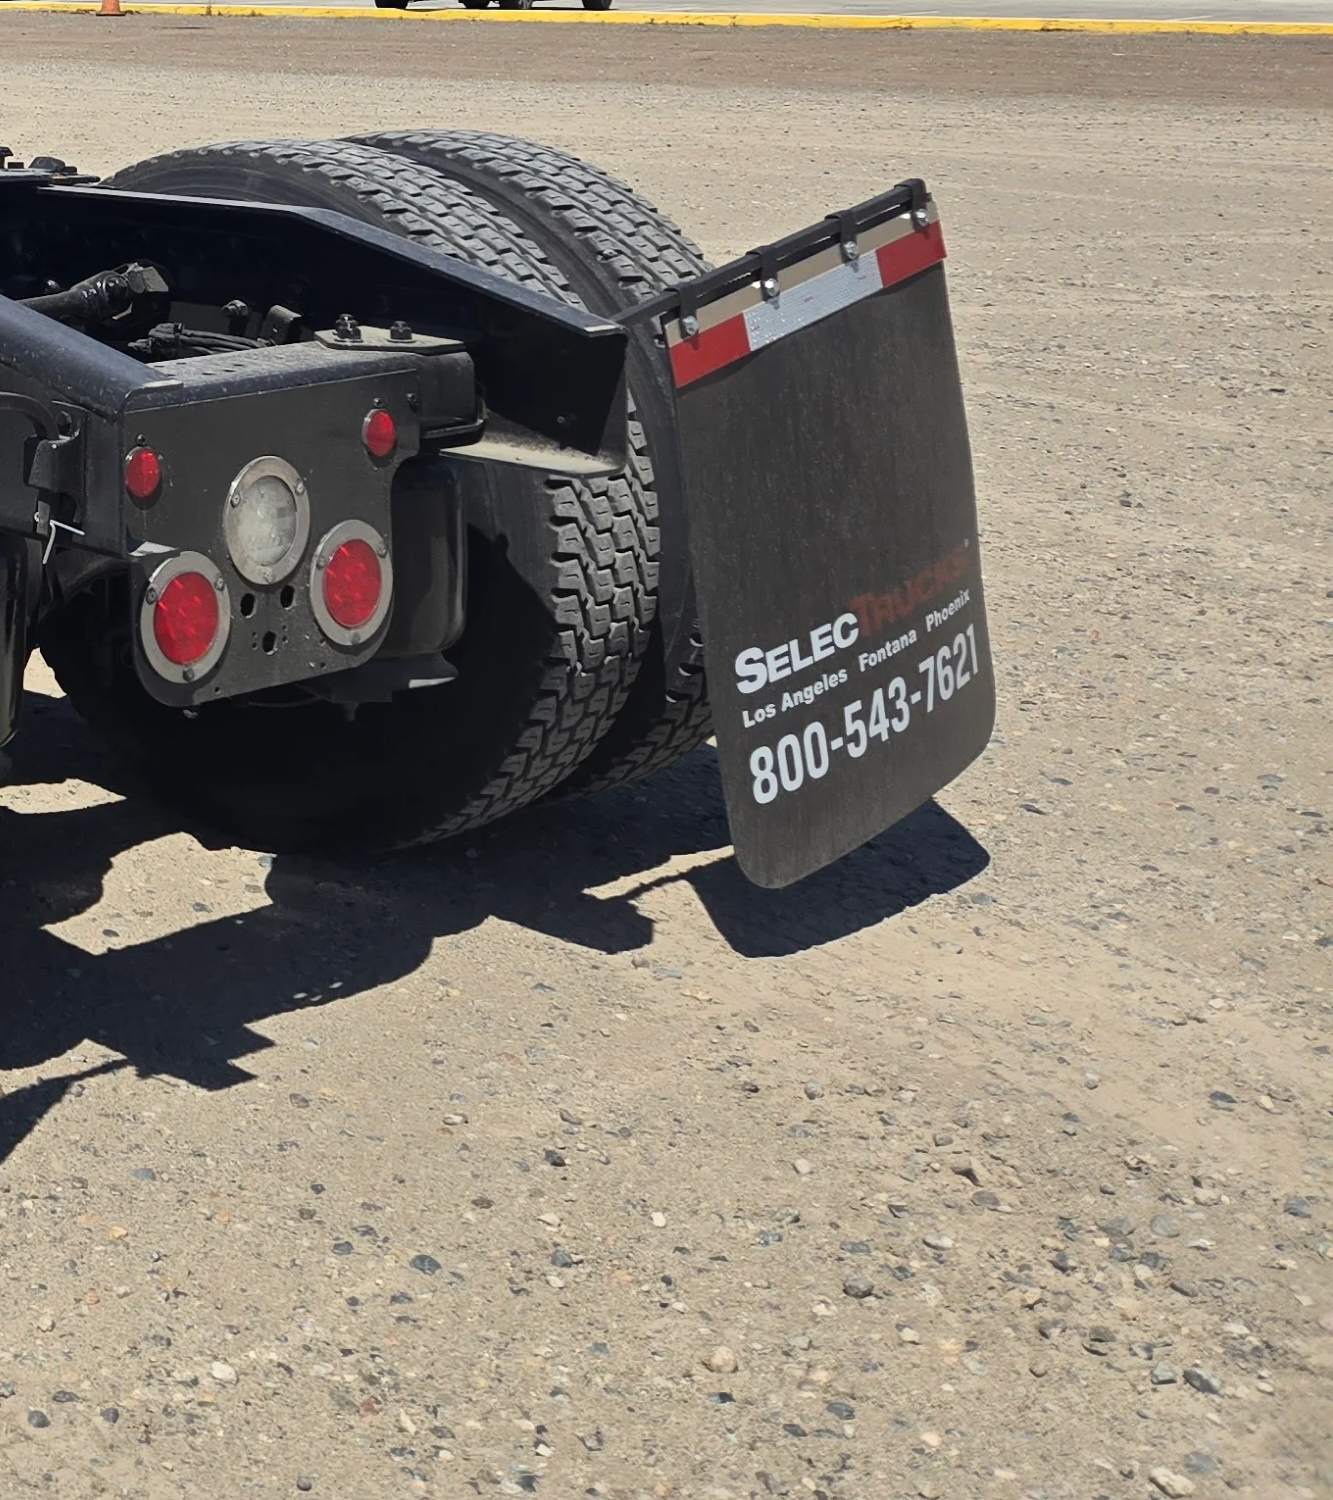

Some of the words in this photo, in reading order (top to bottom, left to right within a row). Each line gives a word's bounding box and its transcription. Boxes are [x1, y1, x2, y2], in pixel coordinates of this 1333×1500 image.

[742, 702, 776, 728] Los
[781, 667, 848, 712] Angeles
[858, 629, 917, 672] Fontana
[926, 587, 970, 631] Phoenix
[750, 623, 978, 804] 800-543-7621
